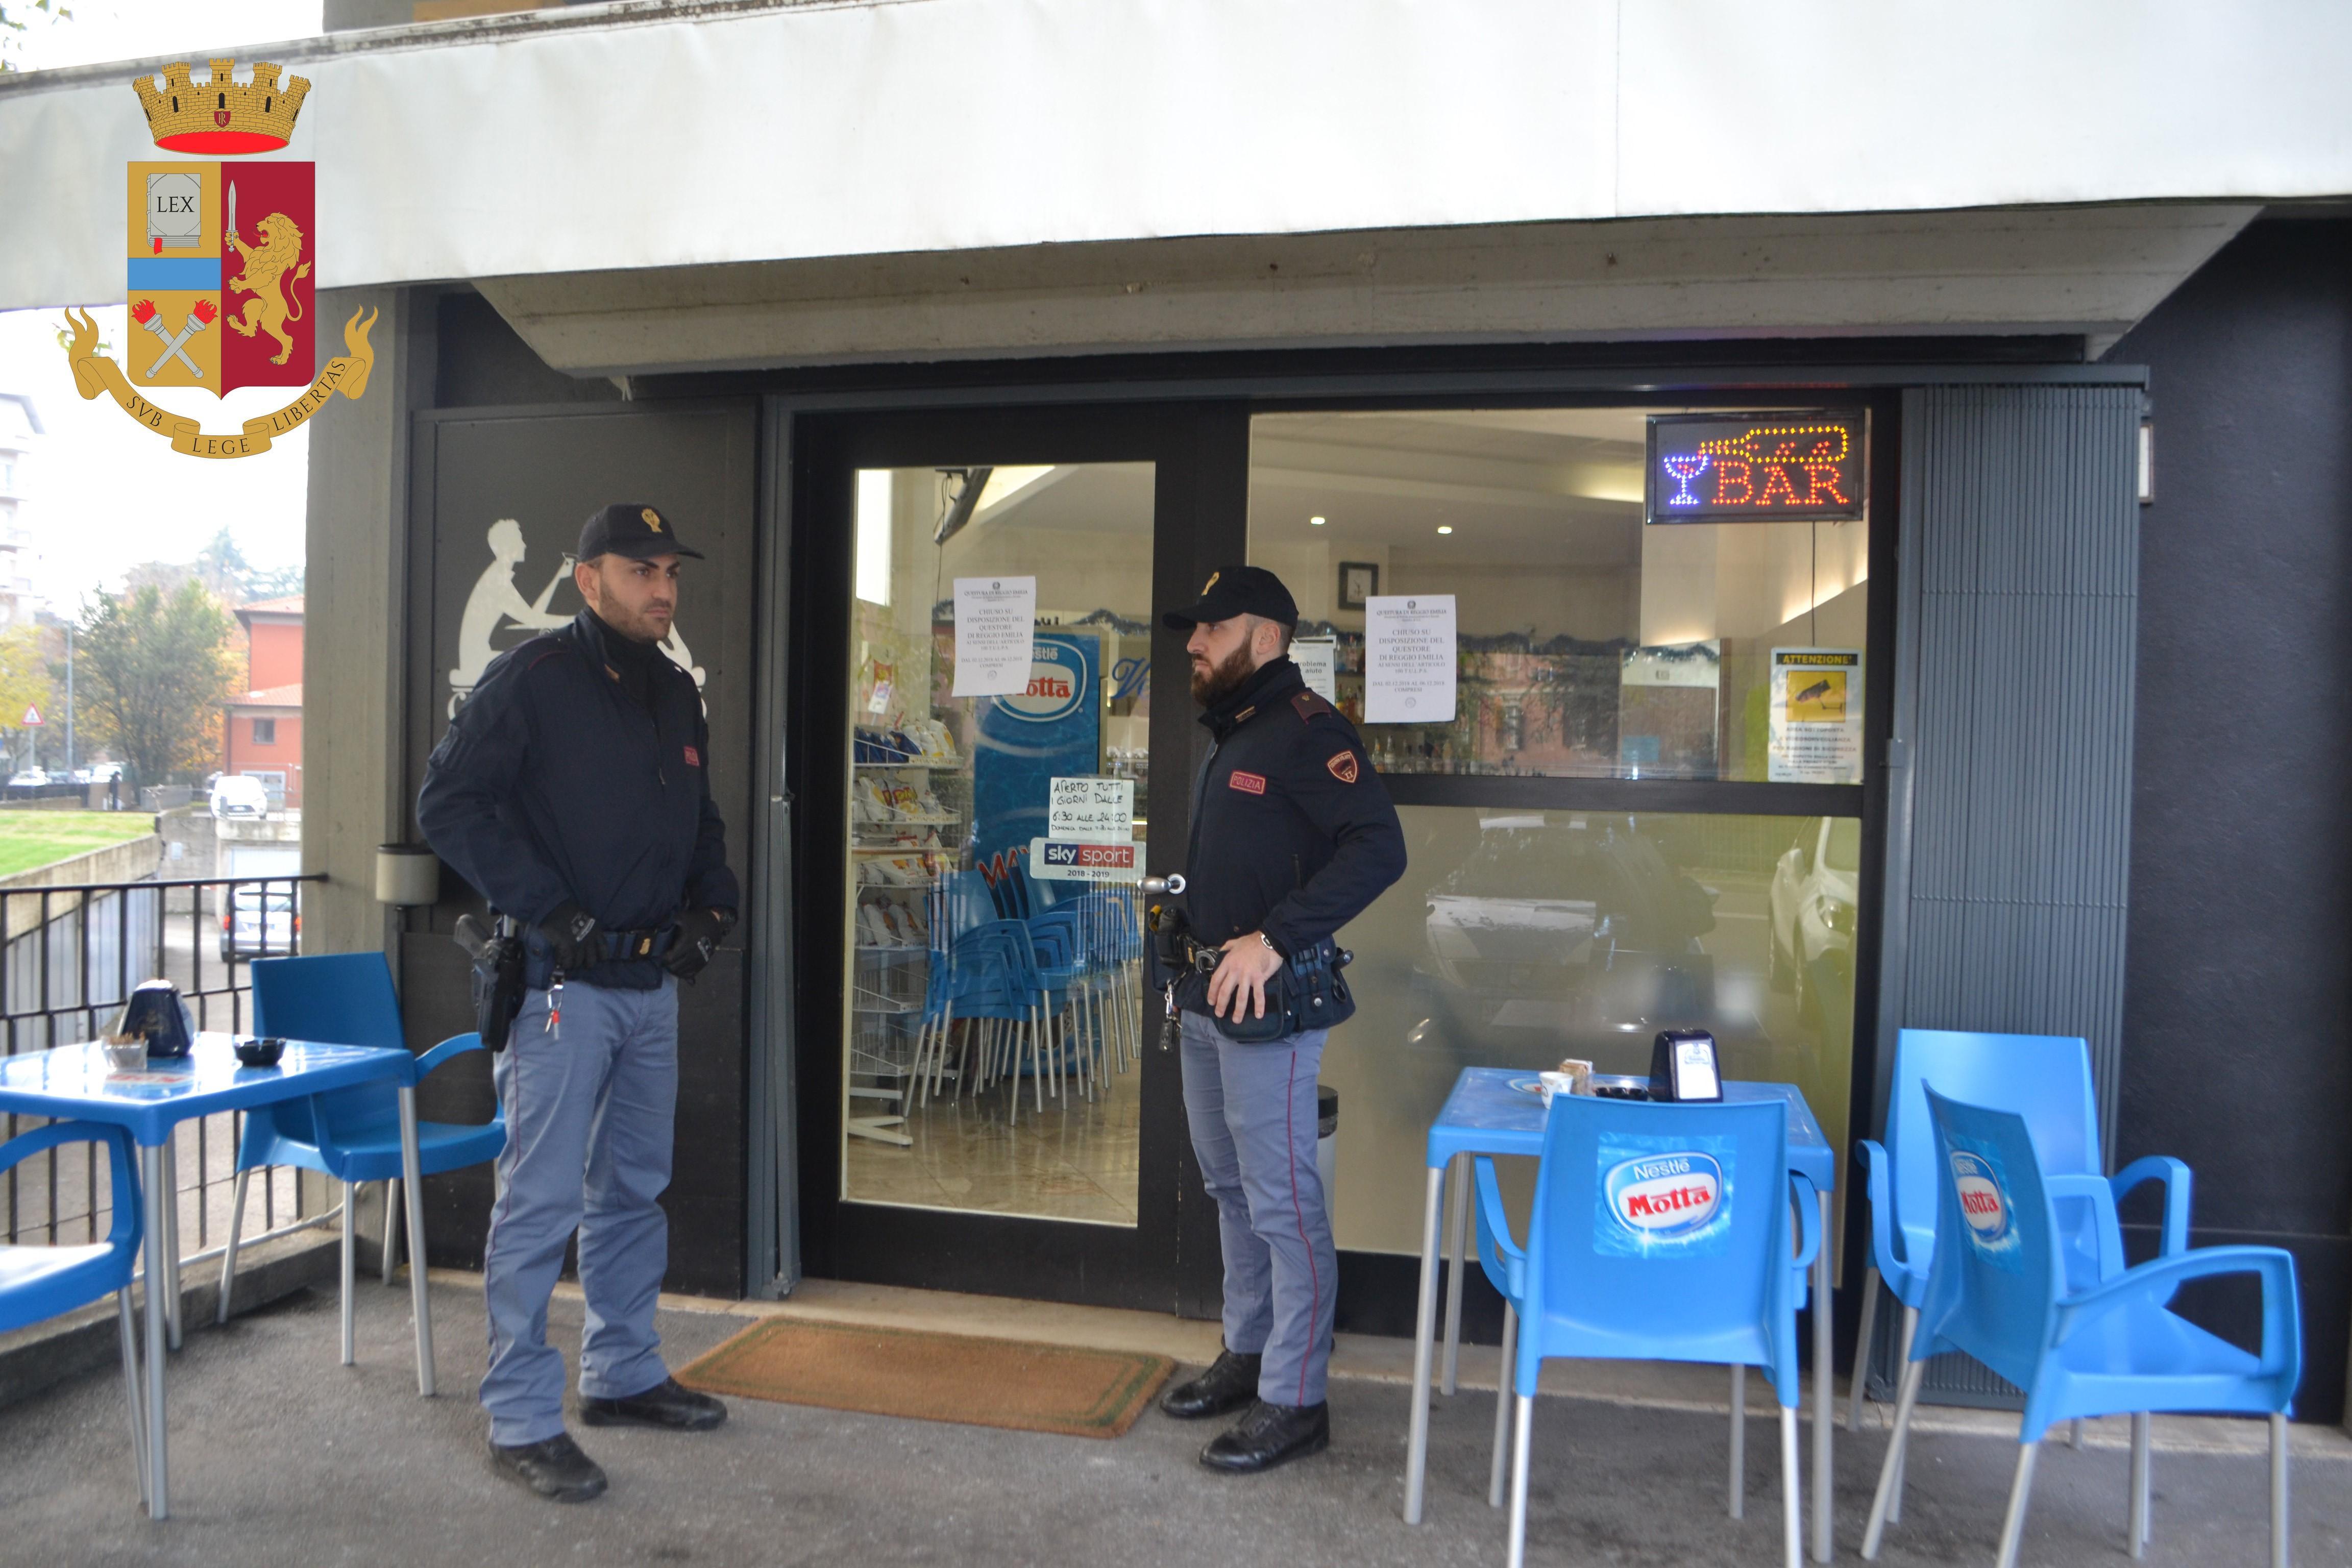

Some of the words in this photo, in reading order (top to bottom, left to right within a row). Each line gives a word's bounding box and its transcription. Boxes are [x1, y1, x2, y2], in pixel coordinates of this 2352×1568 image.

[1712, 461, 1850, 506] BAR
[1025, 677, 1071, 698] otta
[1233, 775, 1260, 790] POLIZIA
[1095, 793, 1123, 804] DALLE
[1052, 811, 1073, 822] 6:30
[1097, 813, 1126, 822] 24:00
[1048, 845, 1076, 864] sky
[1083, 848, 1130, 865] sport
[1633, 1158, 1690, 1180] Nestlé
[1627, 1186, 1711, 1218] Motta
